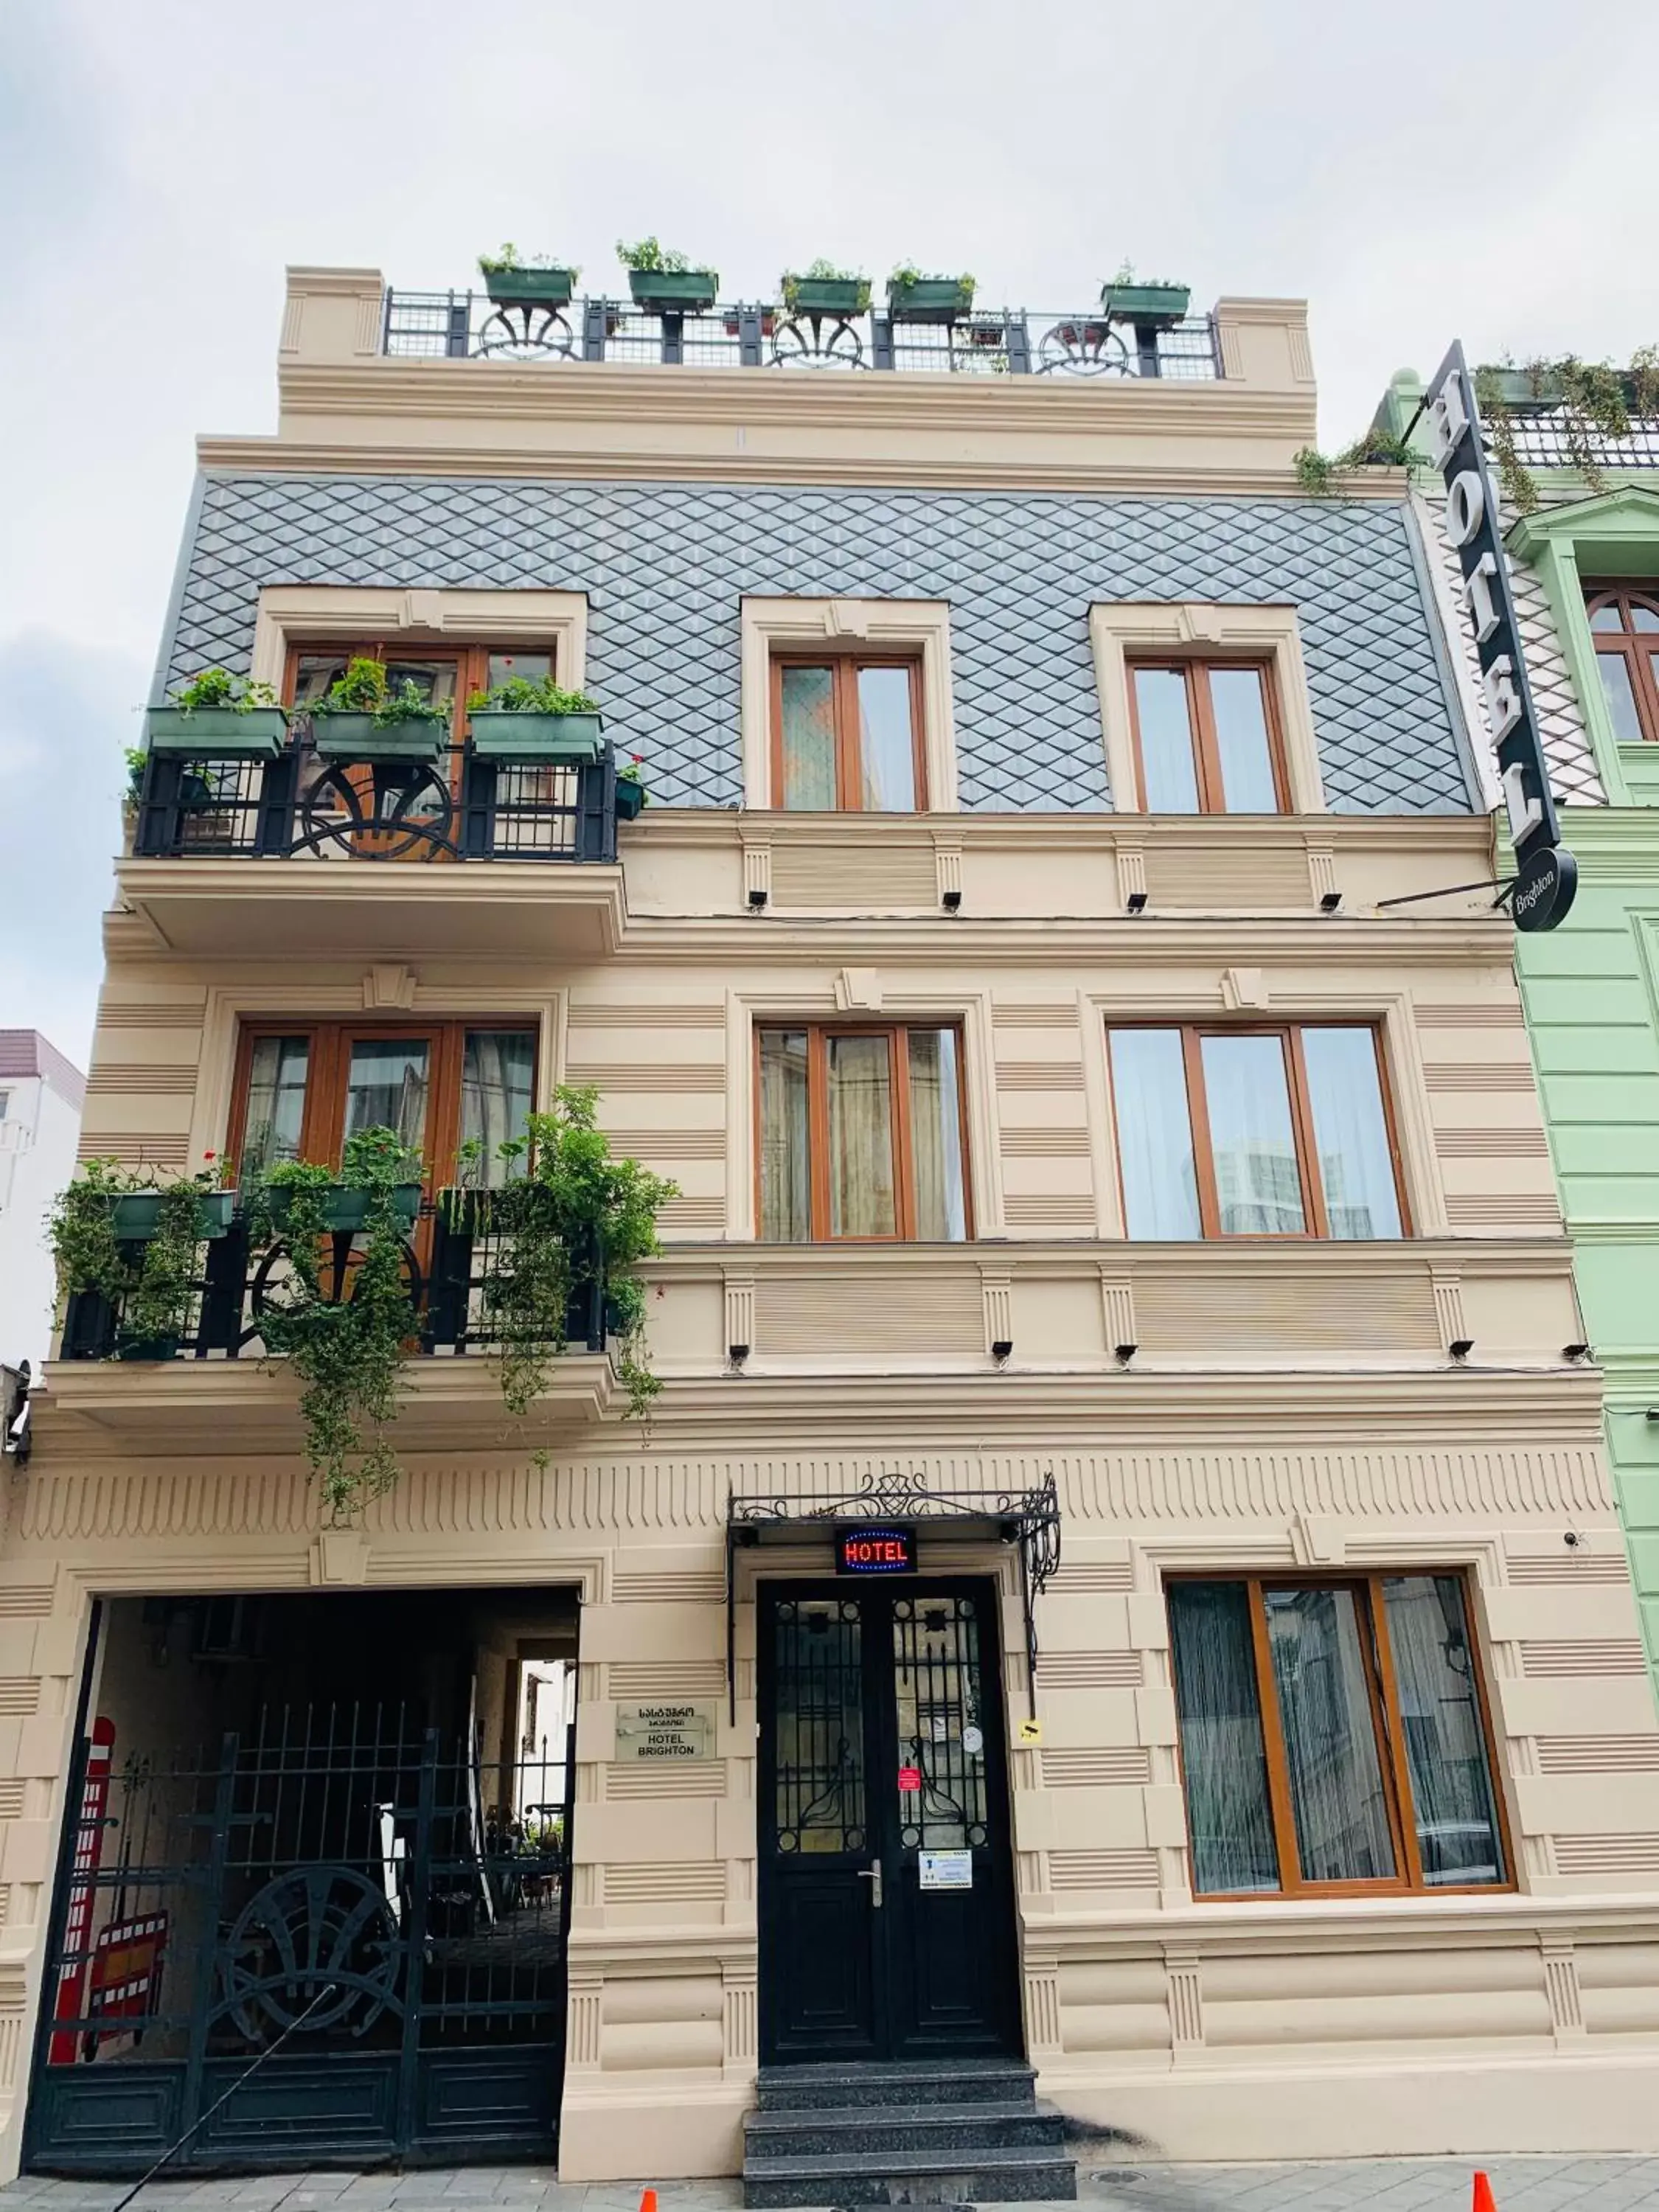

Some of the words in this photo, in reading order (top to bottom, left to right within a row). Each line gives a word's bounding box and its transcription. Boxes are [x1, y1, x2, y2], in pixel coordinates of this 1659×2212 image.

[1434, 369, 1543, 848] HOTEL
[1515, 870, 1554, 915] Brighton
[845, 1542, 908, 1562] HOTEL
[648, 1734, 685, 1744] HOTEL
[638, 1745, 695, 1756] BRIGHTON
